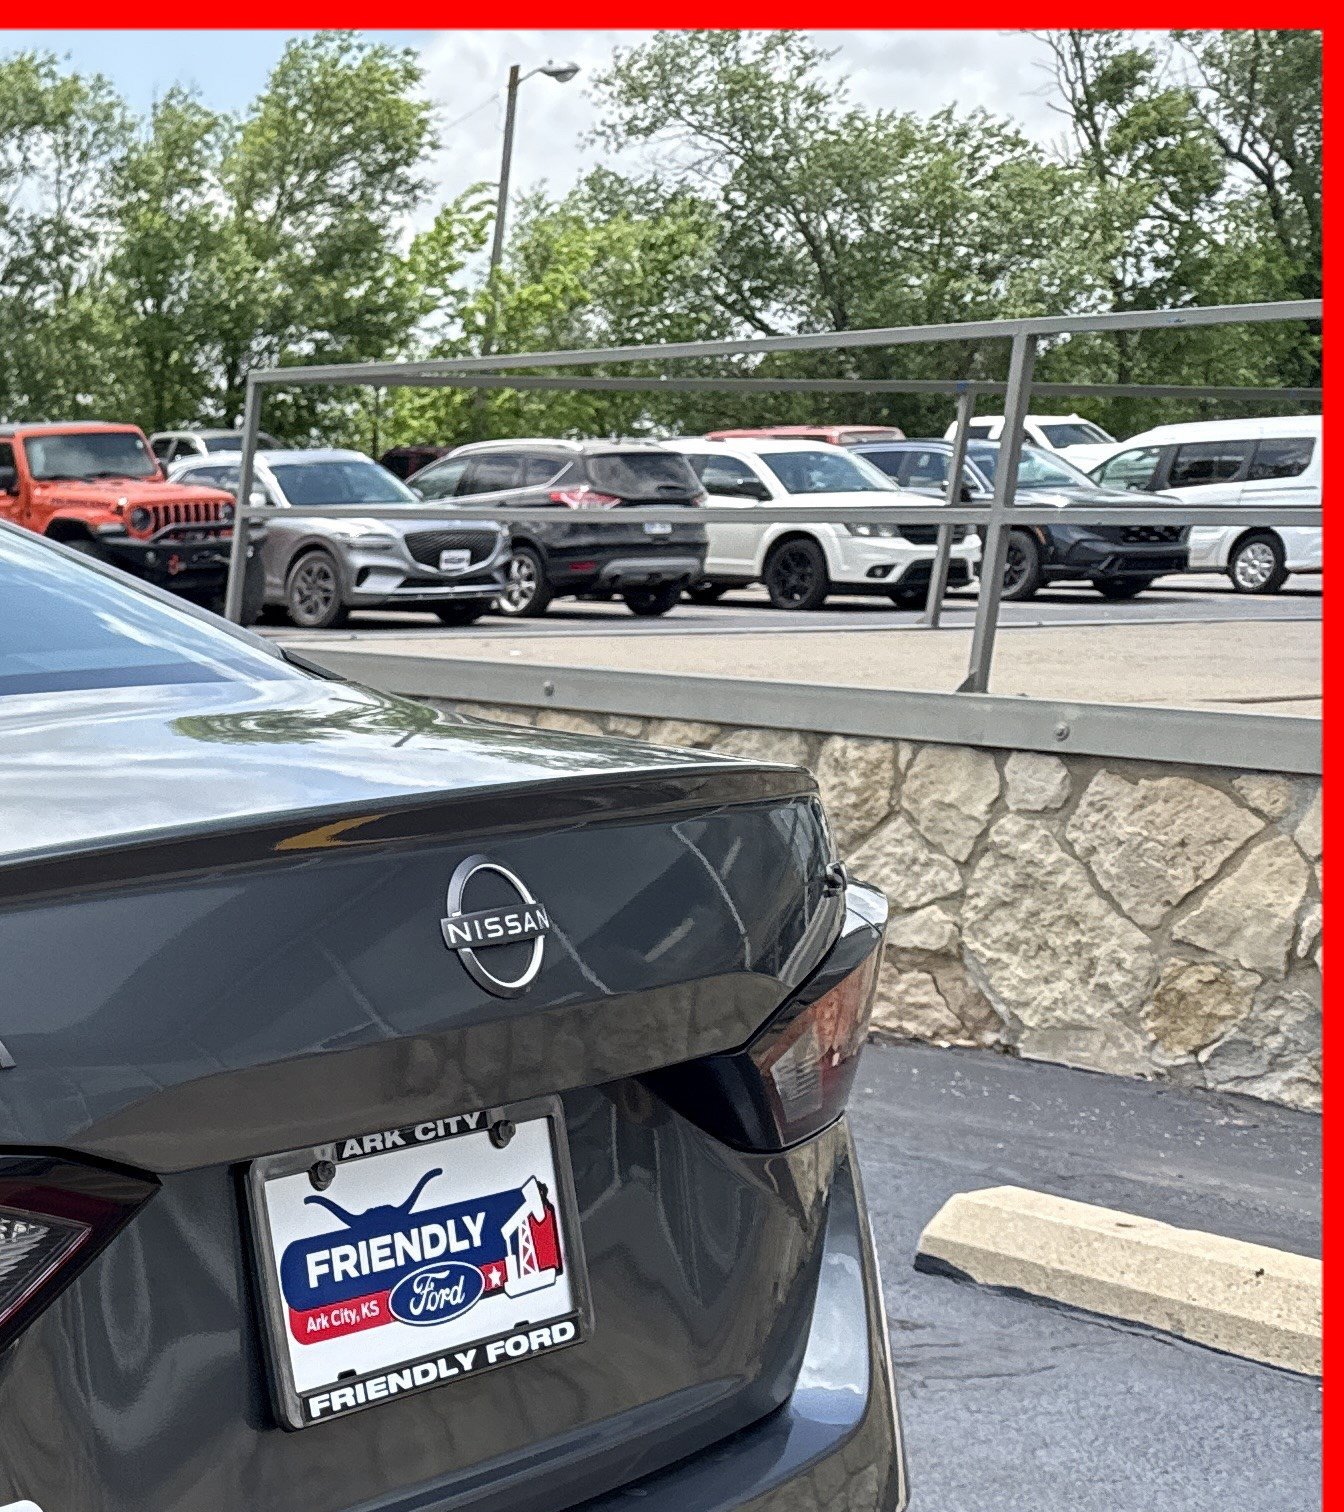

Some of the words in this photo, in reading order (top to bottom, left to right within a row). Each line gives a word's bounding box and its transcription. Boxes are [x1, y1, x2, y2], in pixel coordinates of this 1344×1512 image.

[447, 909, 550, 944] NISSAN
[341, 1129, 407, 1159] ARK
[414, 1110, 481, 1142] CITY
[305, 1211, 486, 1289] FRIENDLY
[306, 1313, 330, 1334] Ark
[330, 1306, 361, 1327] City,
[361, 1299, 380, 1318] KS
[409, 1269, 466, 1316] Ford
[308, 1348, 477, 1418] FRIENDLY
[485, 1320, 576, 1364] FORD
